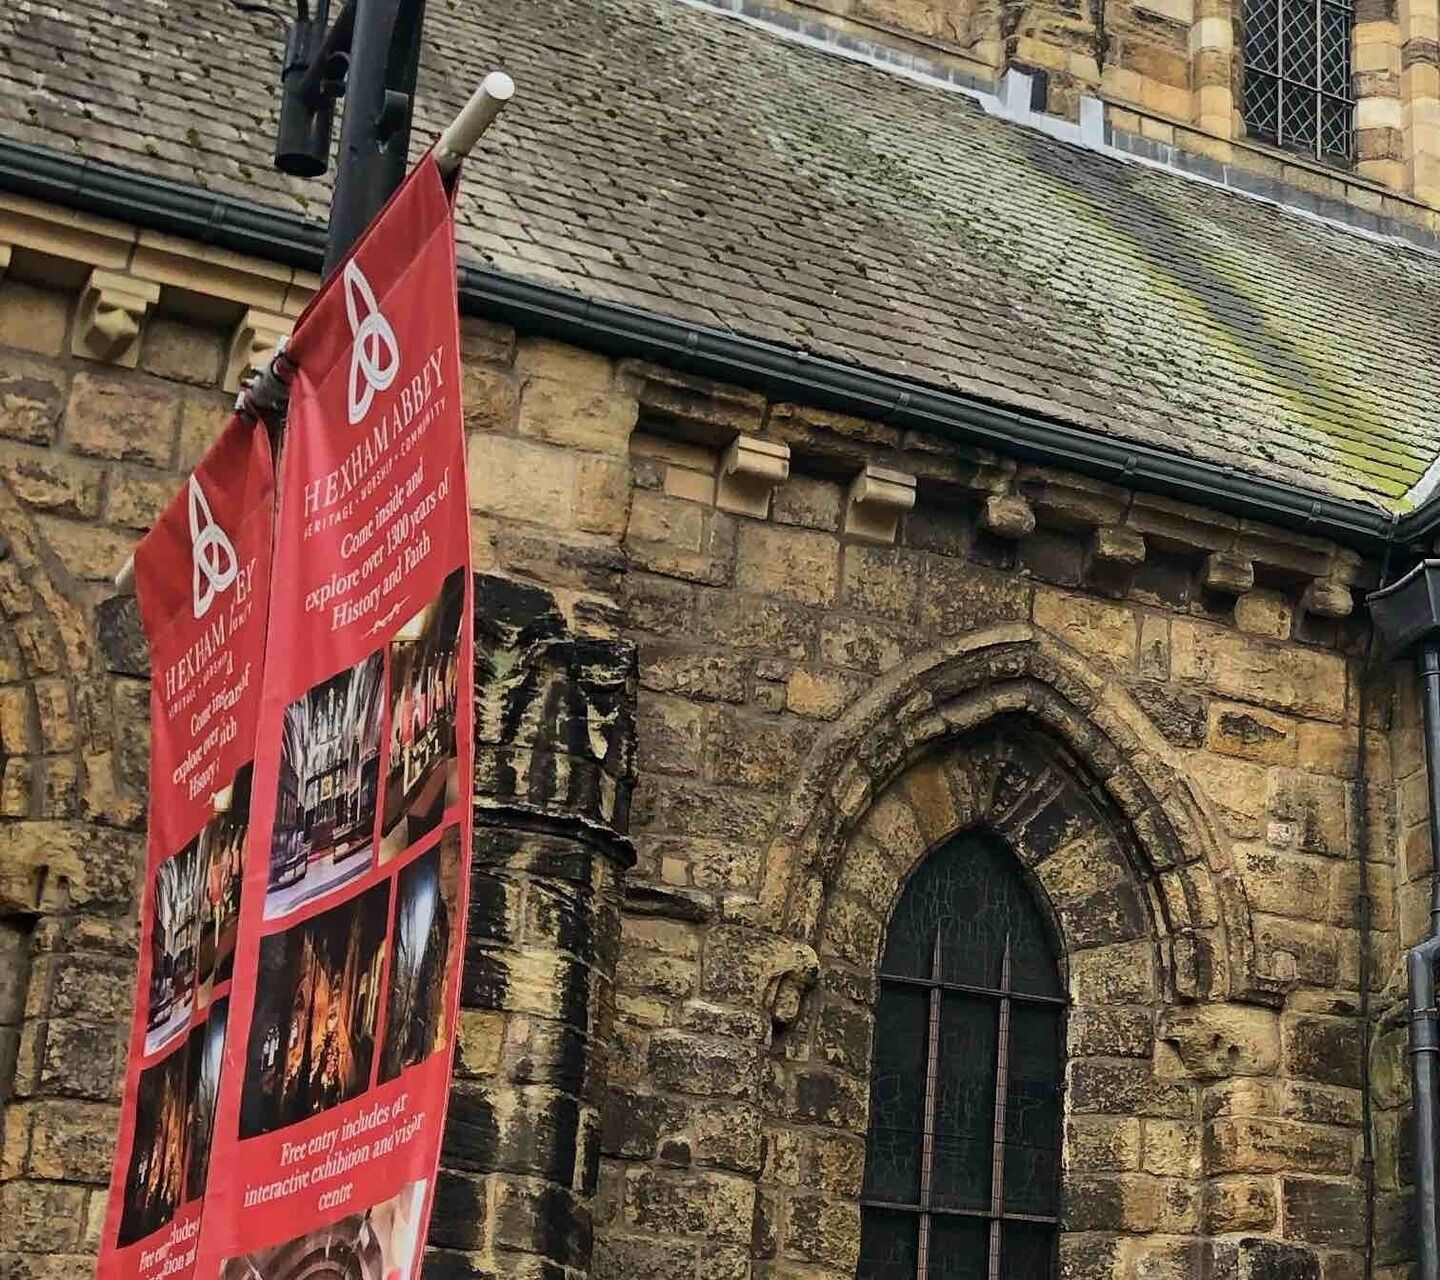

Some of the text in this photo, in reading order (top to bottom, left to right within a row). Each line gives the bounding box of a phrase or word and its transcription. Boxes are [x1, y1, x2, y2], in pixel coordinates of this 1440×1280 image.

[304, 345, 443, 518] HEXHAM ABBEY
[401, 395, 446, 457] COMMUNITY
[305, 568, 359, 612] explore
[361, 543, 385, 579] over
[386, 513, 409, 556] 1300
[410, 490, 437, 540] years
[438, 466, 450, 500] of
[340, 456, 424, 559] Come inside and
[330, 529, 432, 632] History and Faith
[166, 613, 226, 701] HEXHAM
[243, 1169, 310, 1208] interactive
[310, 1142, 369, 1182] exhibition
[371, 1123, 396, 1159] and
[279, 1141, 307, 1167] Free
[308, 1127, 339, 1155] entry
[341, 1102, 389, 1141] includes
